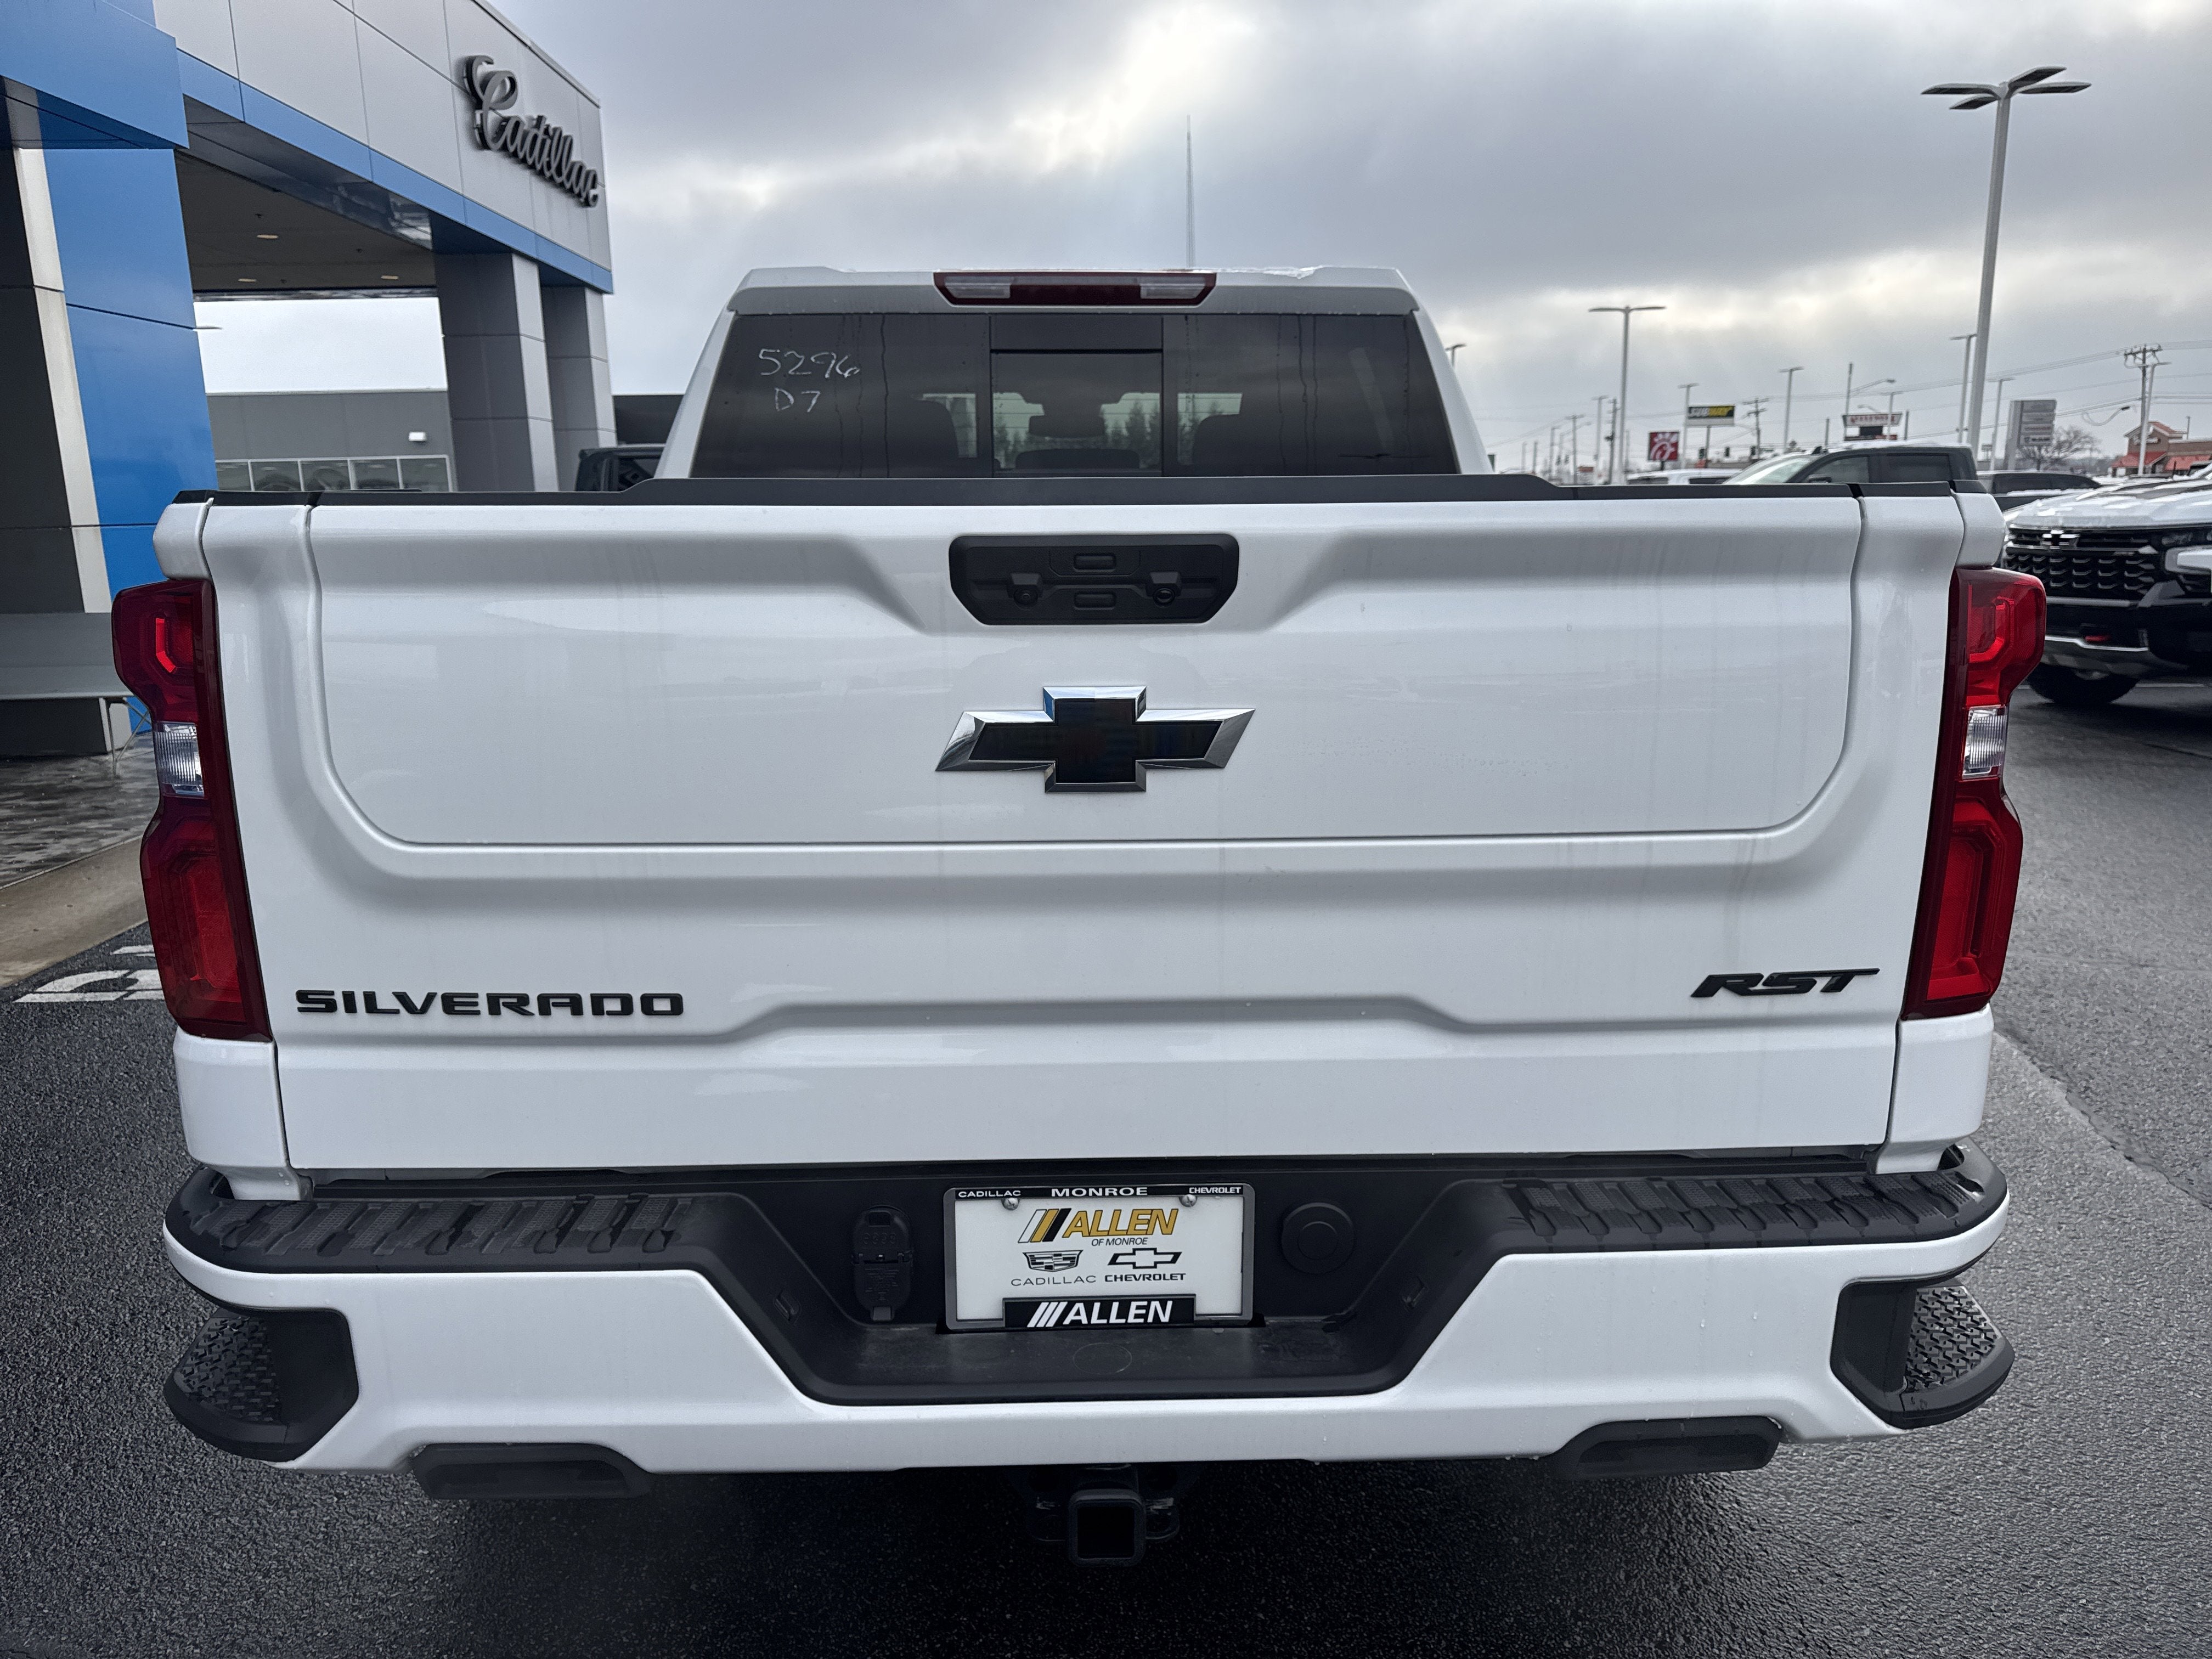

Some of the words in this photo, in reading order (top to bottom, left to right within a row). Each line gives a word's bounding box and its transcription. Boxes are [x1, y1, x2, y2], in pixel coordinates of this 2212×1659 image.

[465, 55, 599, 207] Cadillac
[759, 348, 860, 378] 5296
[1690, 968, 1880, 997] RST
[296, 990, 684, 1016] SILVERADO
[1051, 1187, 1148, 1197] MONROE
[1062, 1208, 1179, 1238] ALLEN
[1105, 1237, 1148, 1246] MONROE
[1011, 1275, 1096, 1286] CADILLAC
[1104, 1273, 1186, 1282] CHEVROLET
[1063, 1300, 1173, 1325] ALLEN
